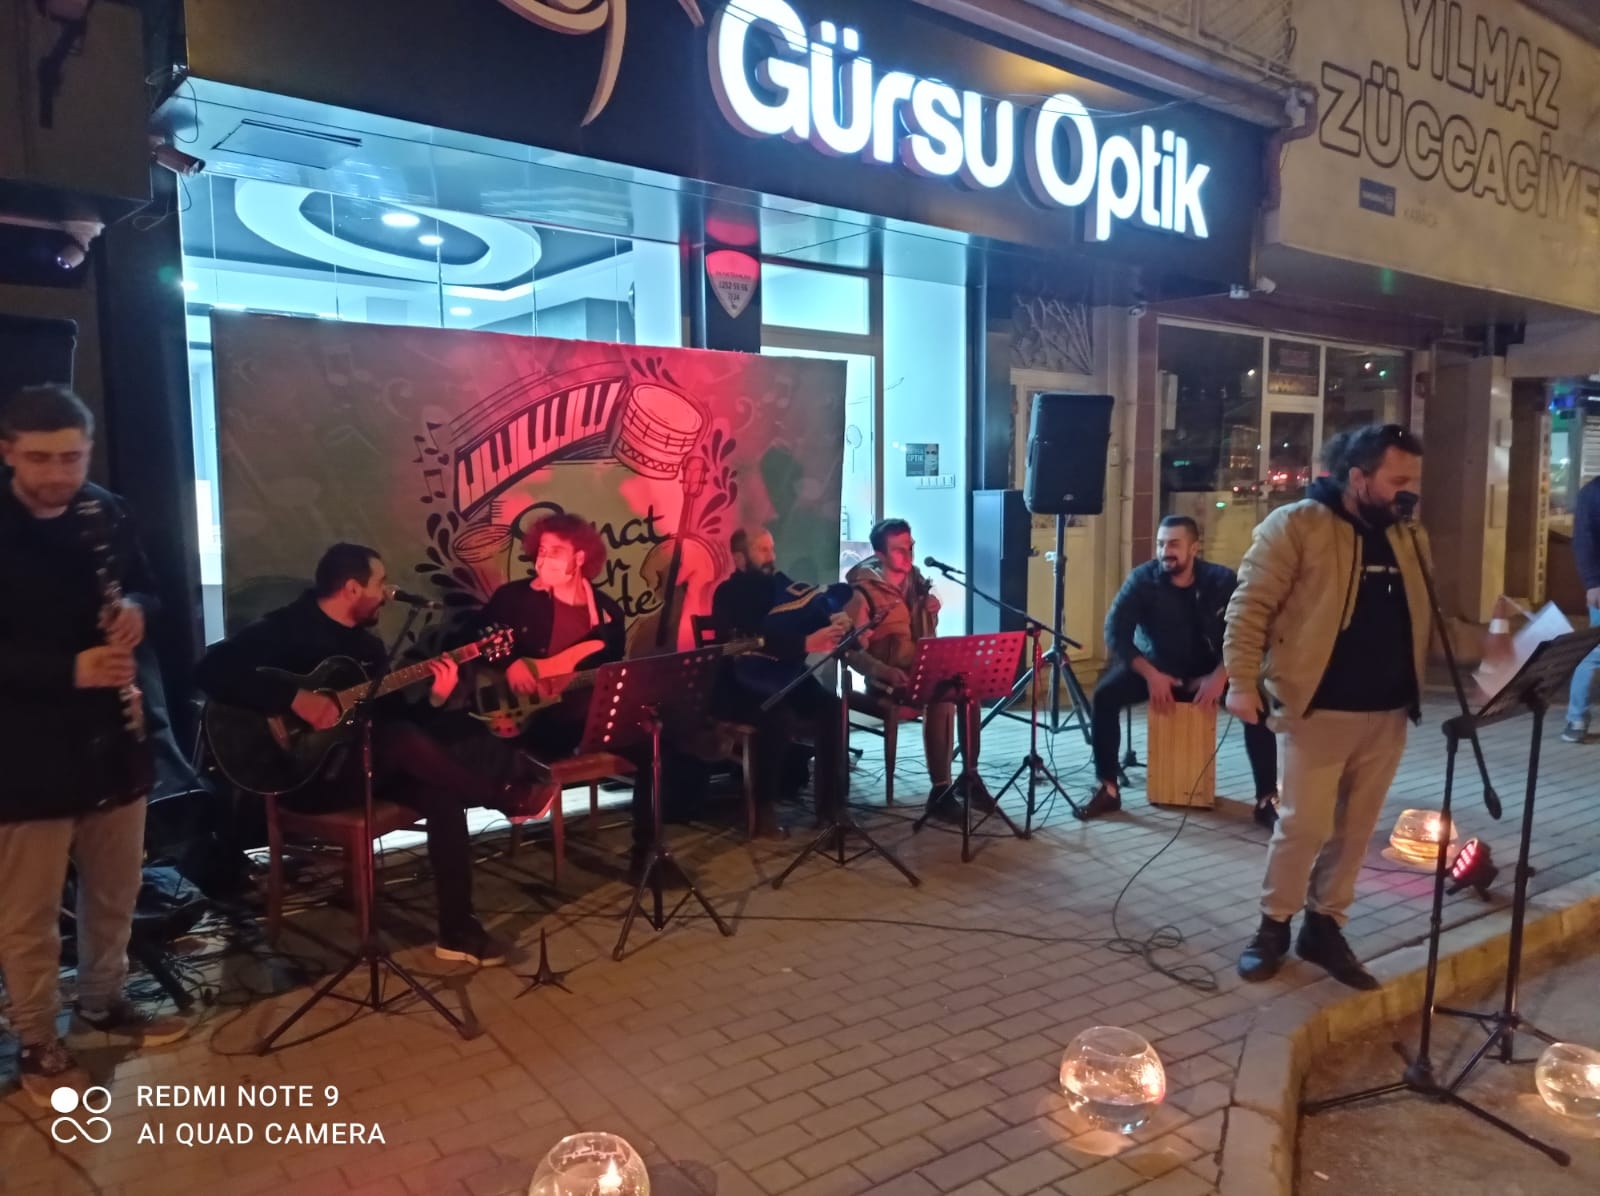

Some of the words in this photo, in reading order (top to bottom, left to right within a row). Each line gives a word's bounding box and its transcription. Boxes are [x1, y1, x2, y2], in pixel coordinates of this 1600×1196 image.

[712, 0, 1014, 189] Gürsu
[1033, 93, 1211, 241] Optik
[1319, 61, 1600, 224] ZÜCCACİYE
[1401, 0, 1561, 130] YILMAZ
